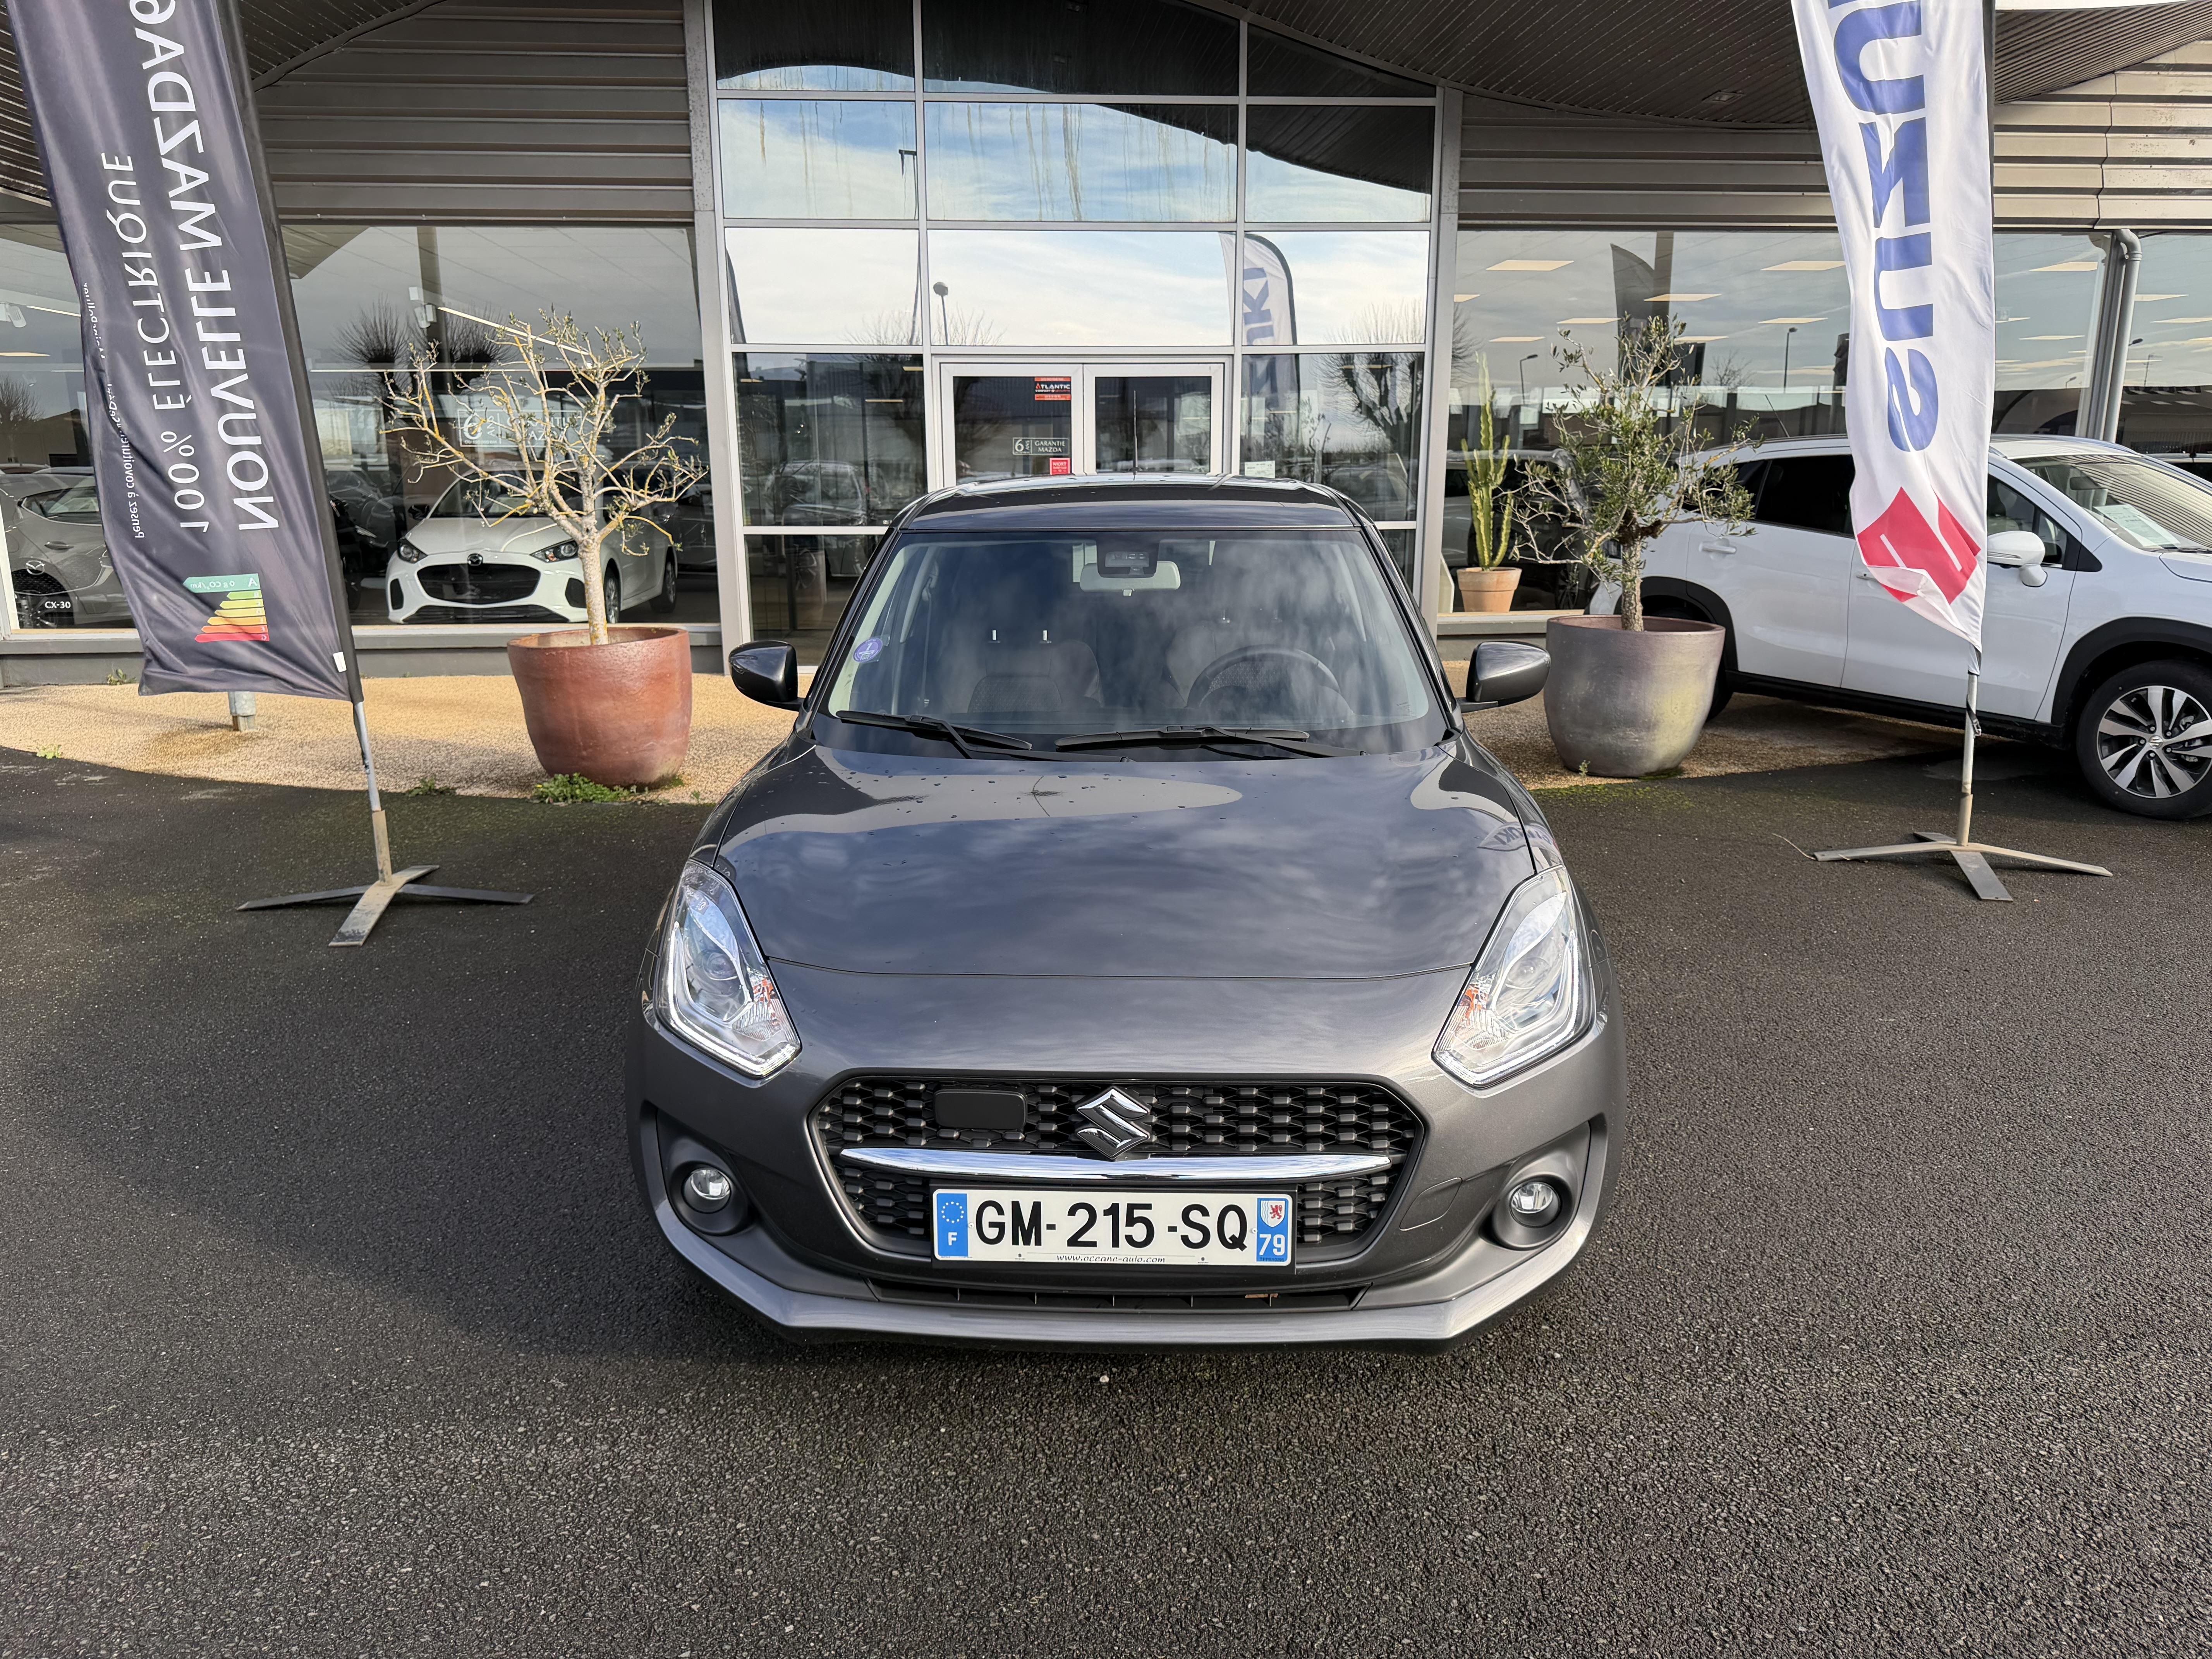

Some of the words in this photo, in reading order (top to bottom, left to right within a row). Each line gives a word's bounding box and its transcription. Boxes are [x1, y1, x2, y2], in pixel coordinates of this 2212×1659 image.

[1015, 439, 1024, 452] 6
[45, 601, 71, 609] CX-30
[975, 1200, 1248, 1252] GM-215-SQ
[948, 1232, 957, 1246] F
[1259, 1234, 1285, 1256] 79
